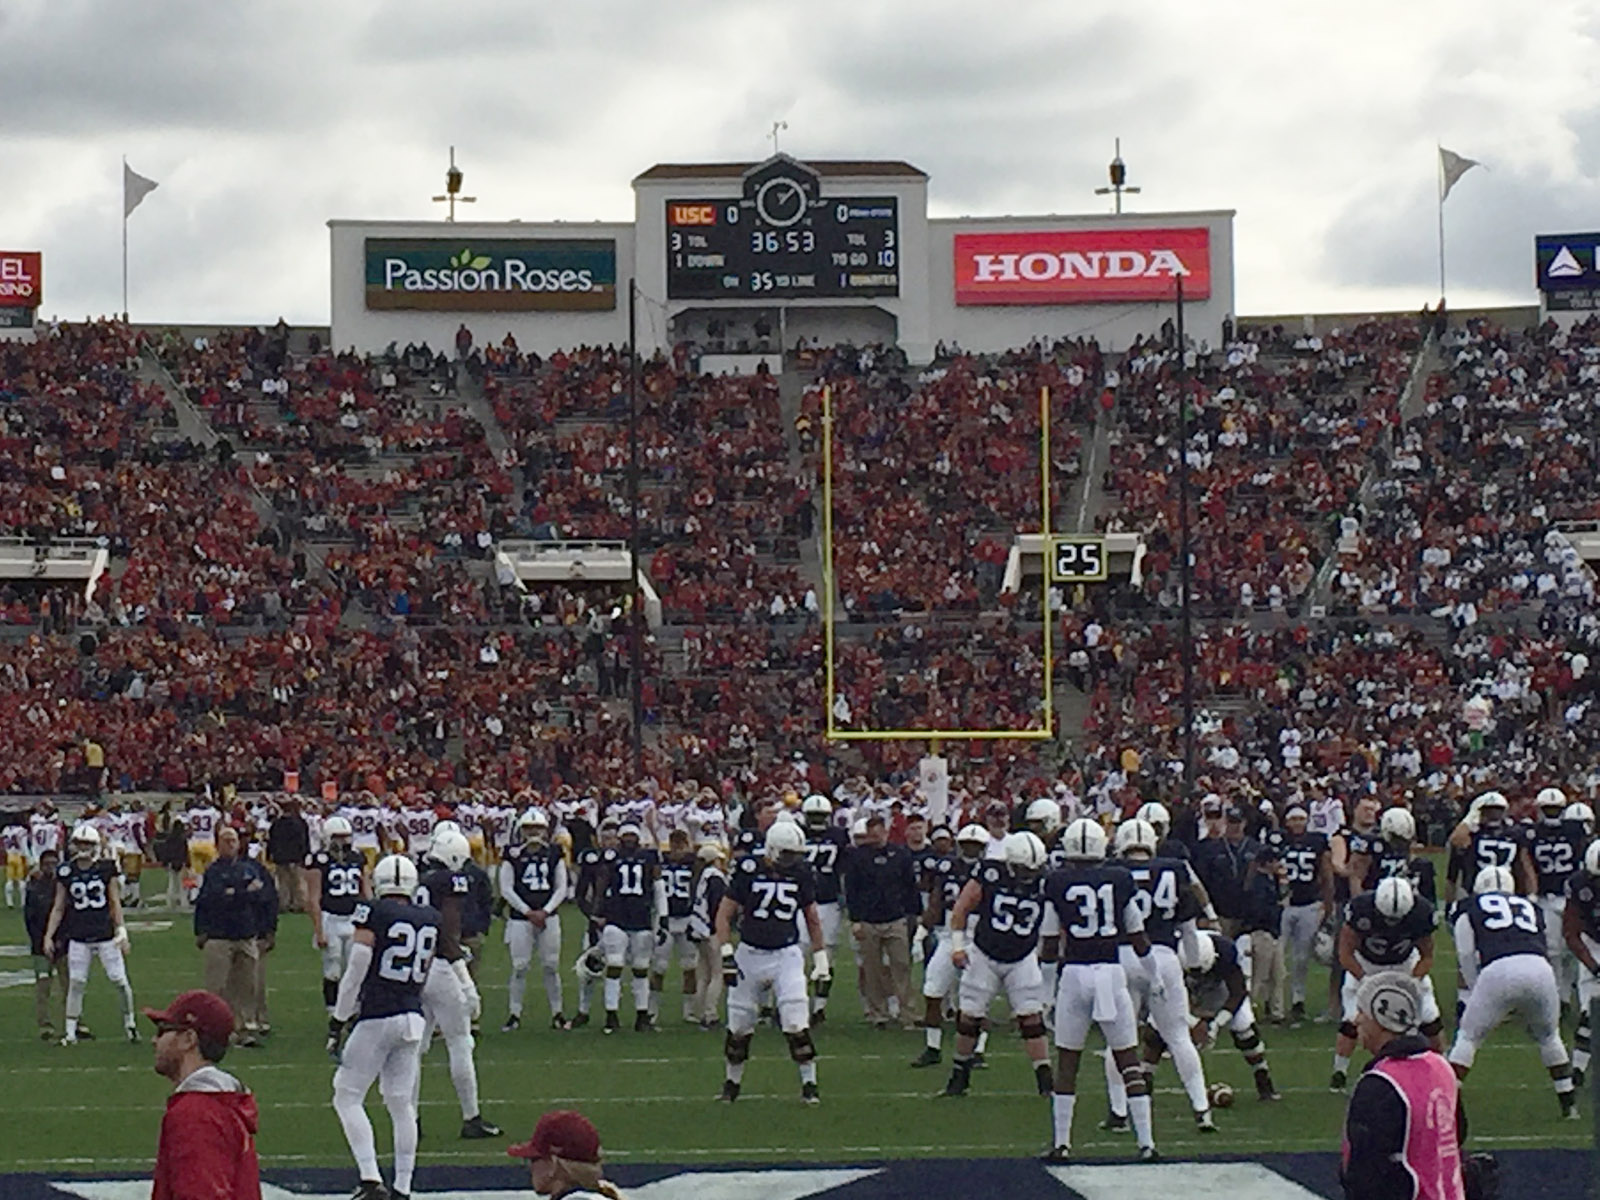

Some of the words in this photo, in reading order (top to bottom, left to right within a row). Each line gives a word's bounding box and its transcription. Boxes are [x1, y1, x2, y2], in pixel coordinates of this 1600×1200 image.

[674, 206, 714, 225] USC
[727, 205, 739, 223] 0
[836, 204, 849, 222] 0
[671, 232, 682, 251] 3
[884, 230, 895, 247] 3
[2, 258, 32, 280] EL
[675, 253, 683, 268] 1
[832, 253, 848, 266] TO
[849, 252, 868, 266] GO
[877, 249, 895, 267] 10
[973, 249, 1192, 281] HONDA
[385, 258, 499, 291] Passion
[505, 259, 592, 292] Roses
[751, 272, 774, 291] 35
[1058, 545, 1100, 575] 25
[192, 815, 212, 831] 93
[1477, 839, 1517, 870] 57
[1535, 843, 1574, 873] 52
[521, 863, 551, 890] 41
[619, 864, 643, 895] 11
[69, 879, 106, 910] 93
[752, 882, 798, 920] 75
[991, 894, 1040, 936] 53
[1065, 884, 1118, 938] 31
[1479, 895, 1538, 933] 93
[378, 921, 438, 984] 28
